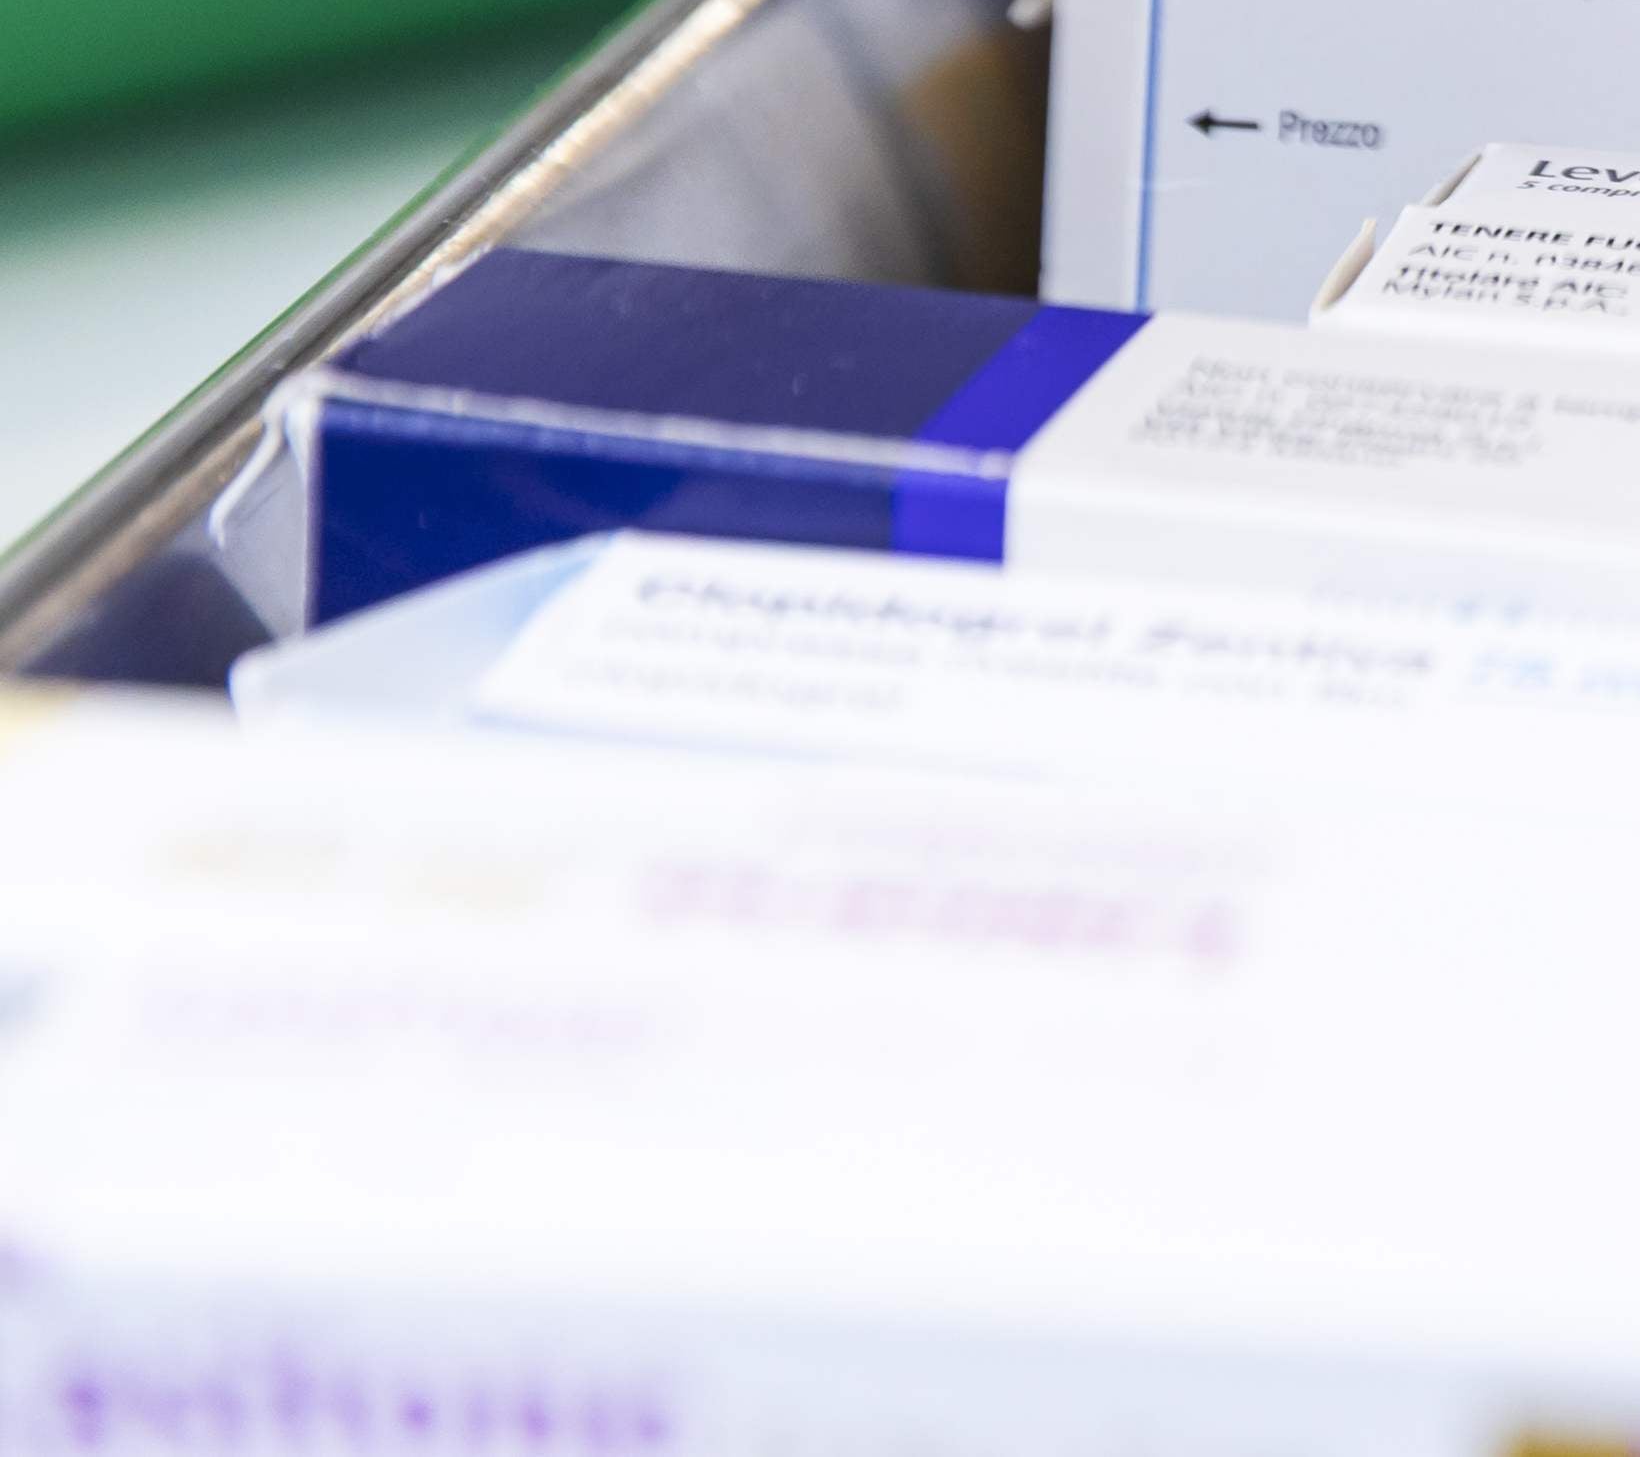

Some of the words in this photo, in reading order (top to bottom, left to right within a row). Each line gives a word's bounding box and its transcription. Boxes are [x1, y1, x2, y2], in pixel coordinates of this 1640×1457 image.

[1279, 109, 1381, 149] Prezzo
[1517, 180, 1535, 191] 5
[1429, 221, 1572, 245] TENERE
